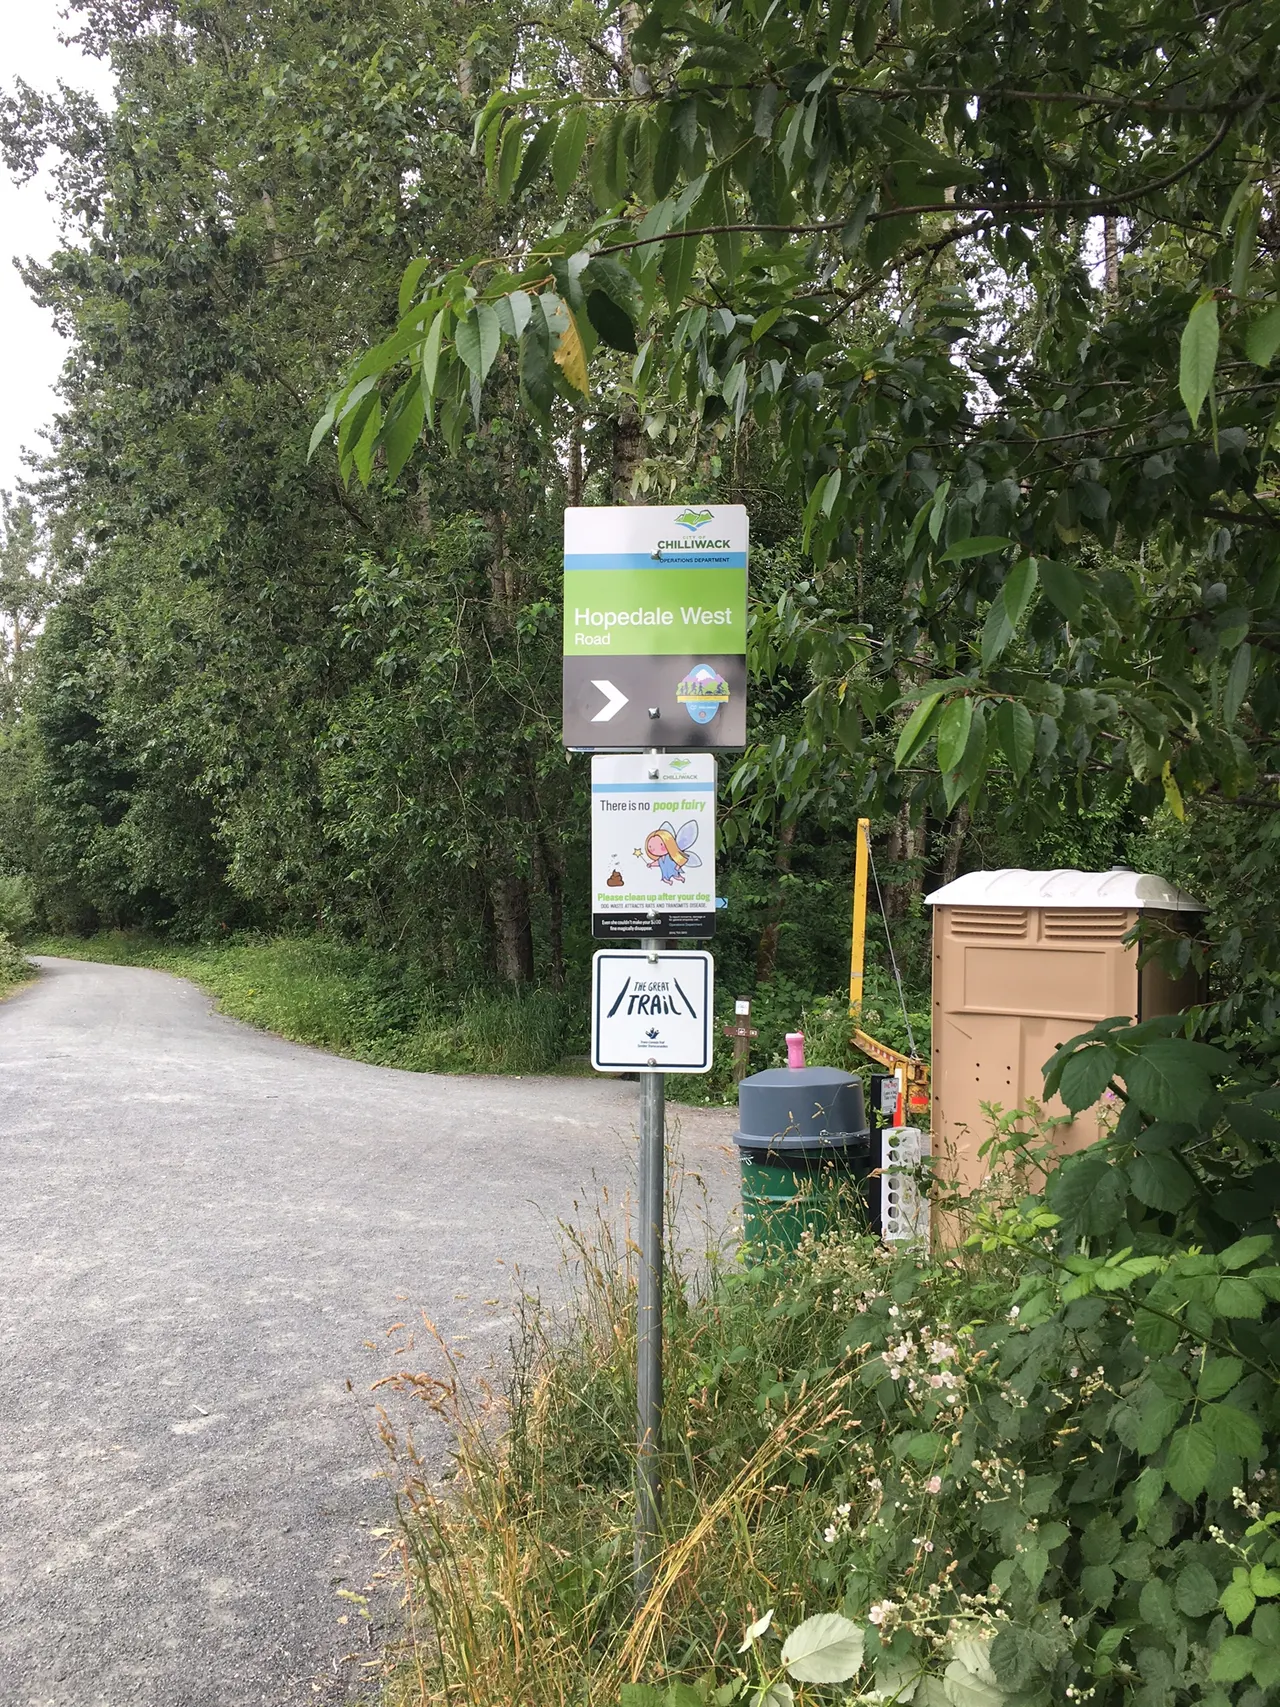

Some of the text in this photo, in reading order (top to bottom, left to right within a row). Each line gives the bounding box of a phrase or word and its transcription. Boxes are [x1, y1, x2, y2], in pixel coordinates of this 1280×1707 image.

[657, 539, 731, 549] CHILLIWACK
[574, 606, 733, 631] Hopedale West
[574, 632, 611, 646] Road
[600, 799, 706, 813] There is no poop fairy
[597, 891, 711, 903] Please clean up after your dog
[634, 981, 669, 992] THE GREAT
